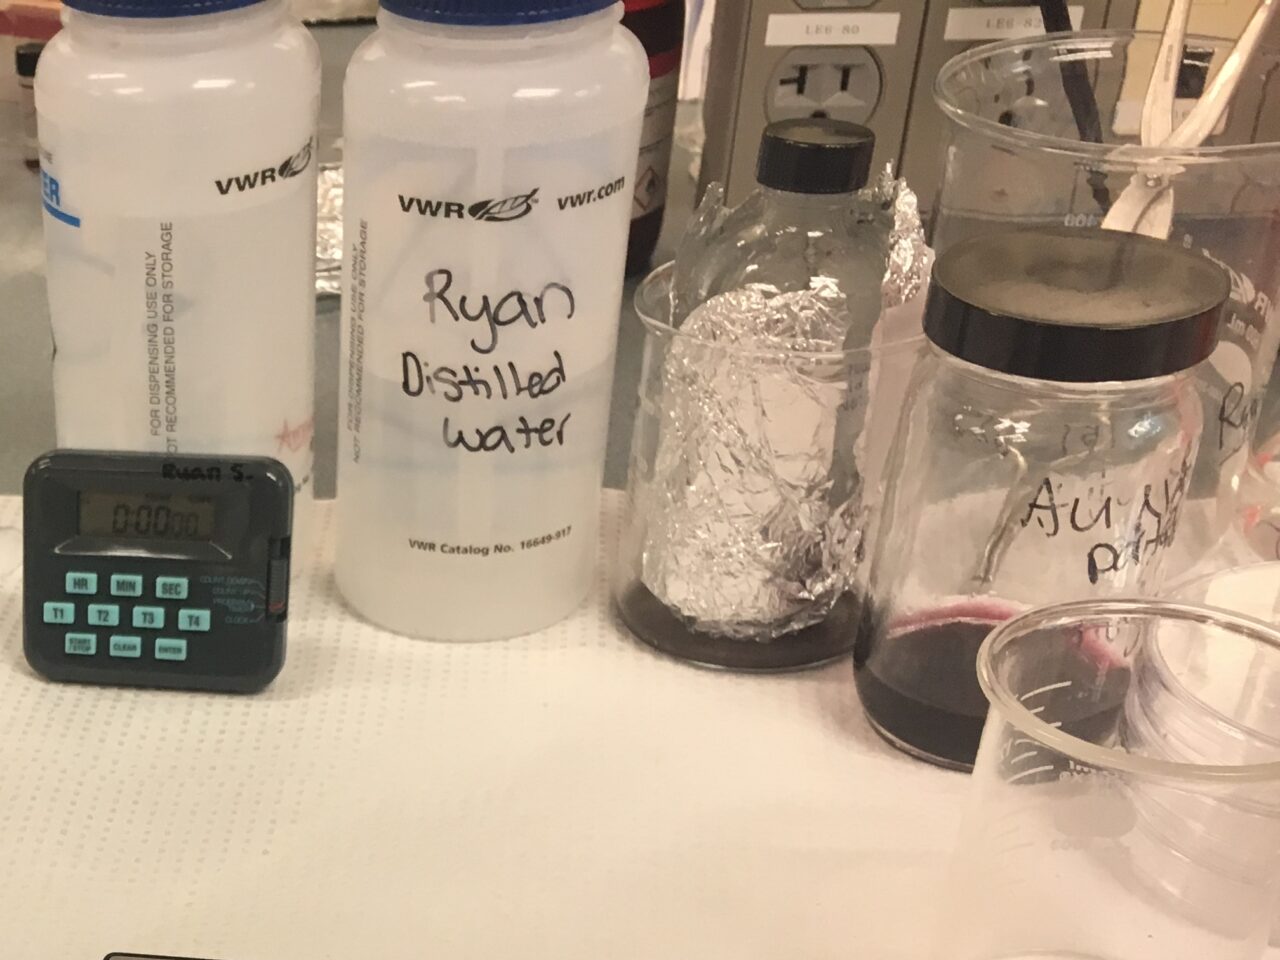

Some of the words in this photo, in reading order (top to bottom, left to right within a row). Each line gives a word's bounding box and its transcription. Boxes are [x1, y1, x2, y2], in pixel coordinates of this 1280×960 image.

[214, 167, 277, 196] VWR
[556, 175, 626, 211] vwr.com
[397, 194, 465, 220] VWR
[144, 250, 158, 288] ONLY
[160, 221, 175, 290] STORAGE
[146, 290, 158, 320] USE
[161, 293, 175, 323] FOR
[422, 268, 576, 355] Ryan
[147, 322, 161, 407] DISPENSING
[163, 325, 178, 434] RECOMMENDED
[401, 350, 567, 403] Distilled
[149, 414, 162, 437] FOR
[166, 437, 179, 456] OT
[161, 462, 221, 483] Ryan
[407, 537, 437, 553] VWR
[439, 542, 490, 557] Catalog
[493, 543, 515, 555] No.
[72, 577, 89, 592] HR
[115, 579, 137, 594] MIN
[161, 581, 183, 596] SEC
[51, 607, 66, 620] T1
[96, 609, 111, 623] T2
[141, 611, 156, 625] T3
[186, 614, 202, 628] T4
